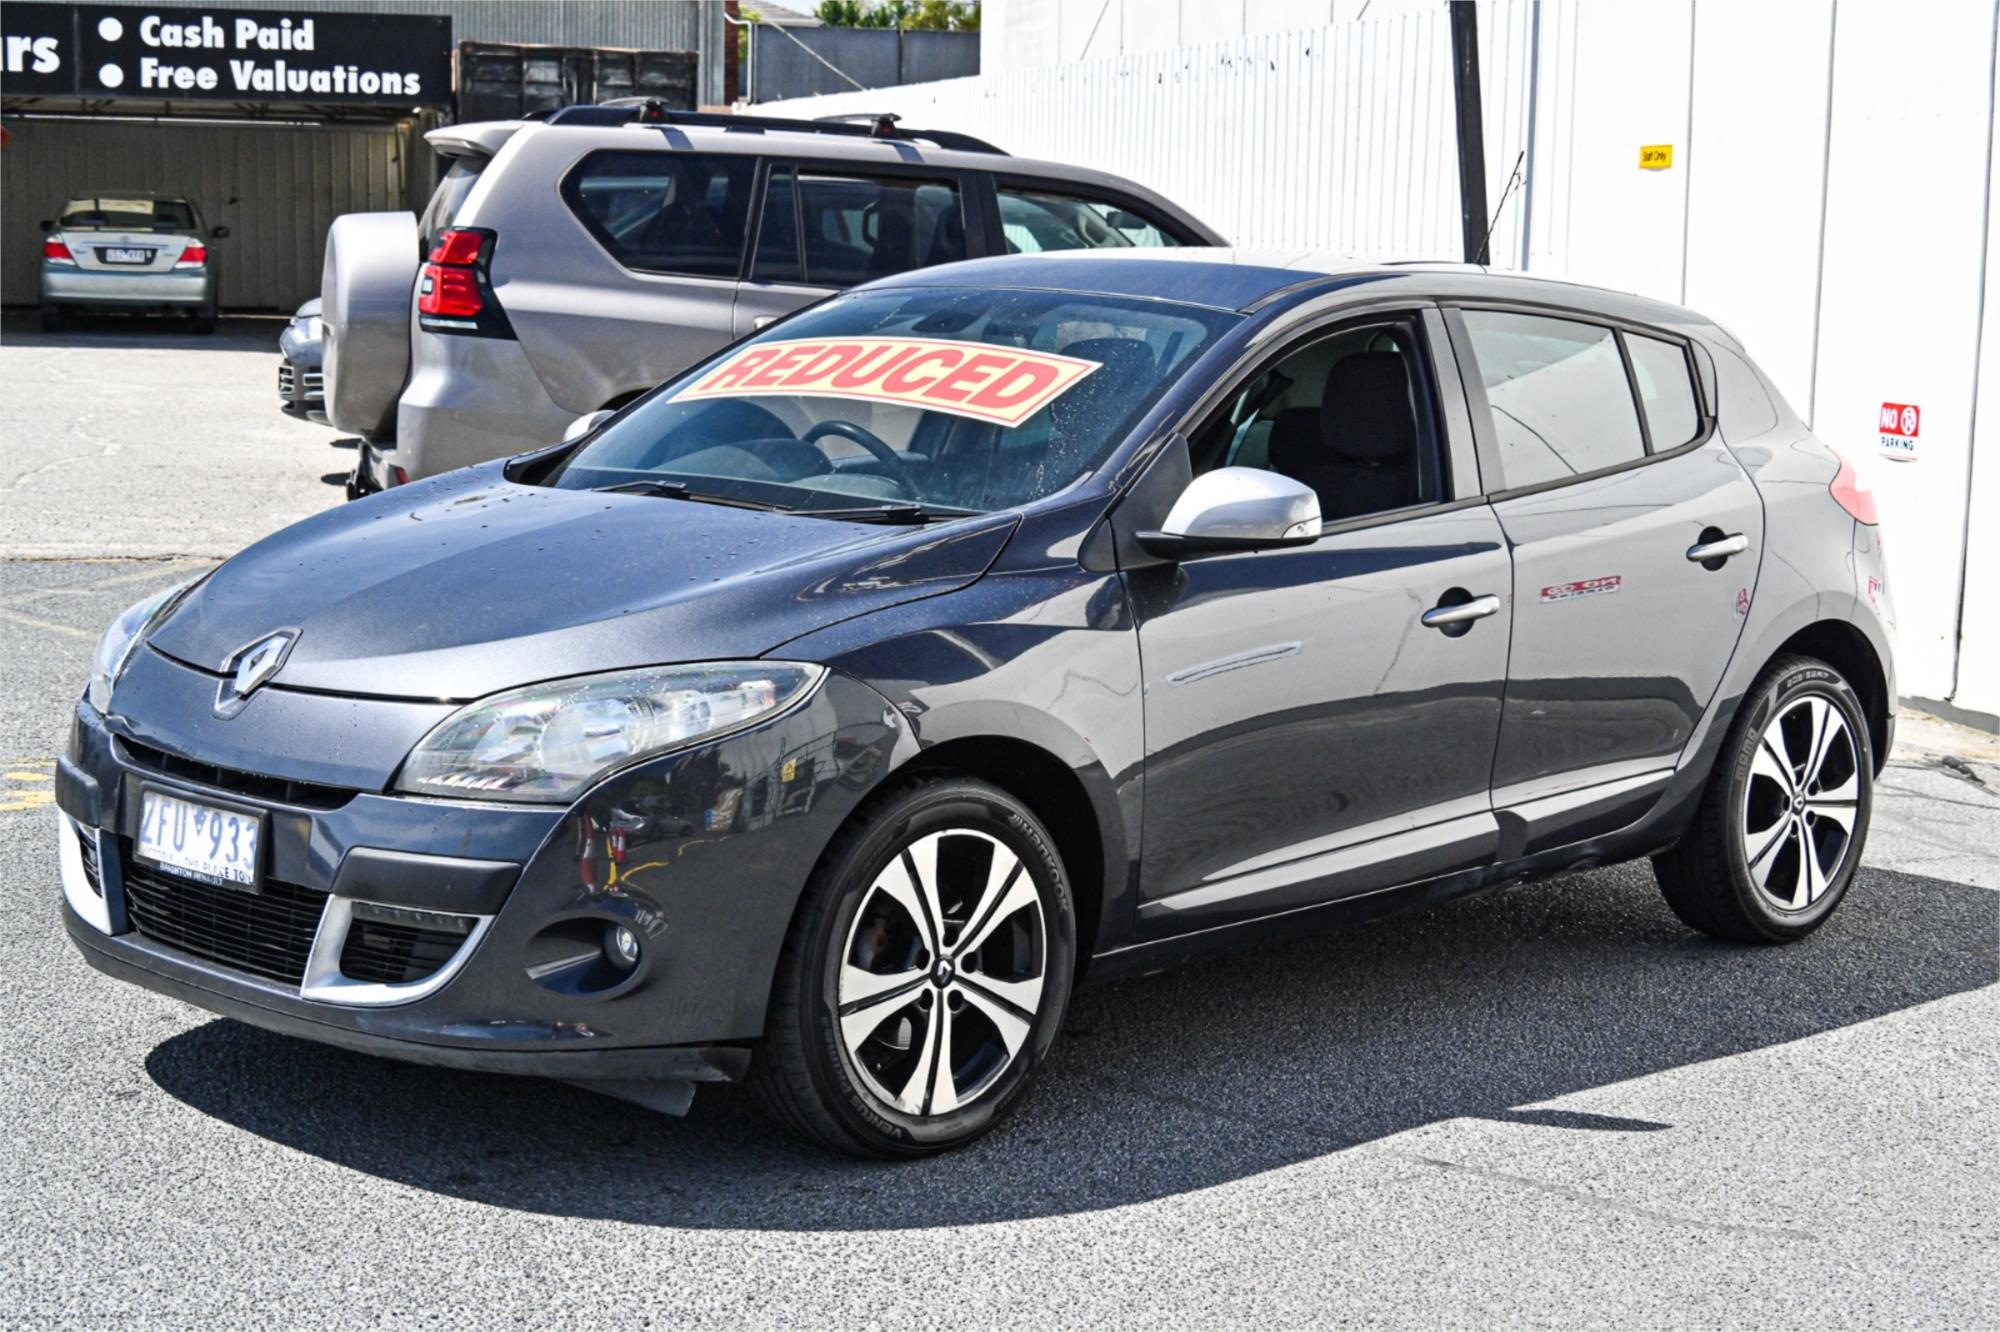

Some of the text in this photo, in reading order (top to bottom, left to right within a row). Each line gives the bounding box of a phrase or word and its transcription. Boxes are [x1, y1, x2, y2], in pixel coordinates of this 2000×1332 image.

[140, 15, 315, 51] Cash Paid
[0, 36, 60, 74] rs
[140, 57, 421, 96] Free Valuations
[702, 345, 1060, 409] REDUCED
[1881, 407, 1898, 430] NO
[1881, 436, 1914, 451] PARKING
[141, 796, 257, 870] ZFU 933
